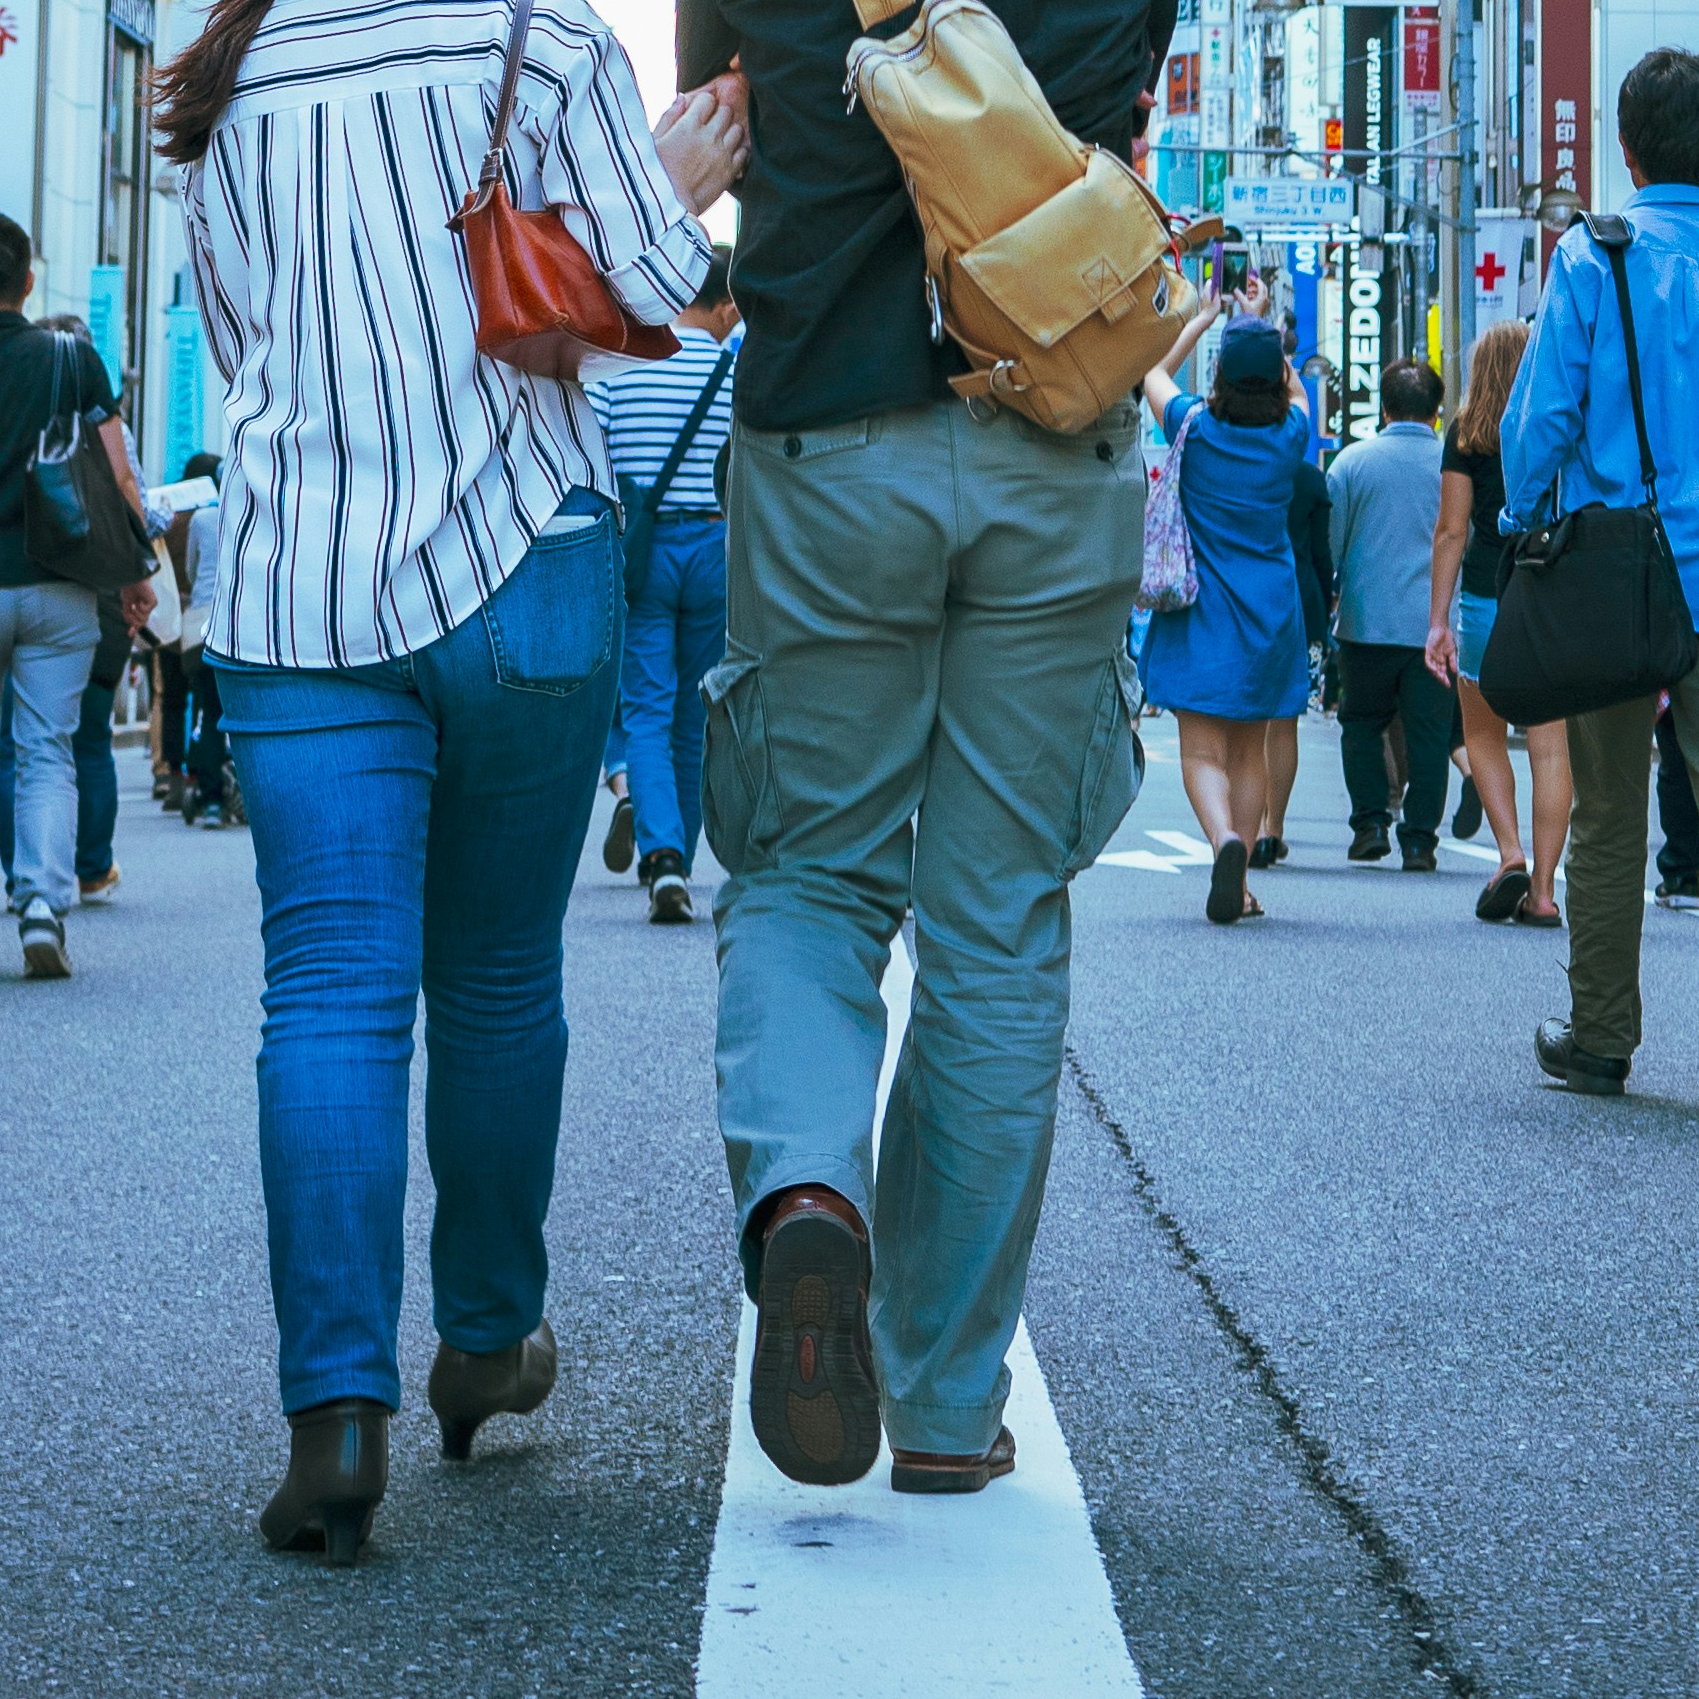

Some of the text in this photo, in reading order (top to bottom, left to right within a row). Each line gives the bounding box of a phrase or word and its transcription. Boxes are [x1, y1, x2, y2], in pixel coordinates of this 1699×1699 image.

[1367, 38, 1381, 123] LEGWEAR
[1232, 184, 1347, 203] 新宿三丁目西
